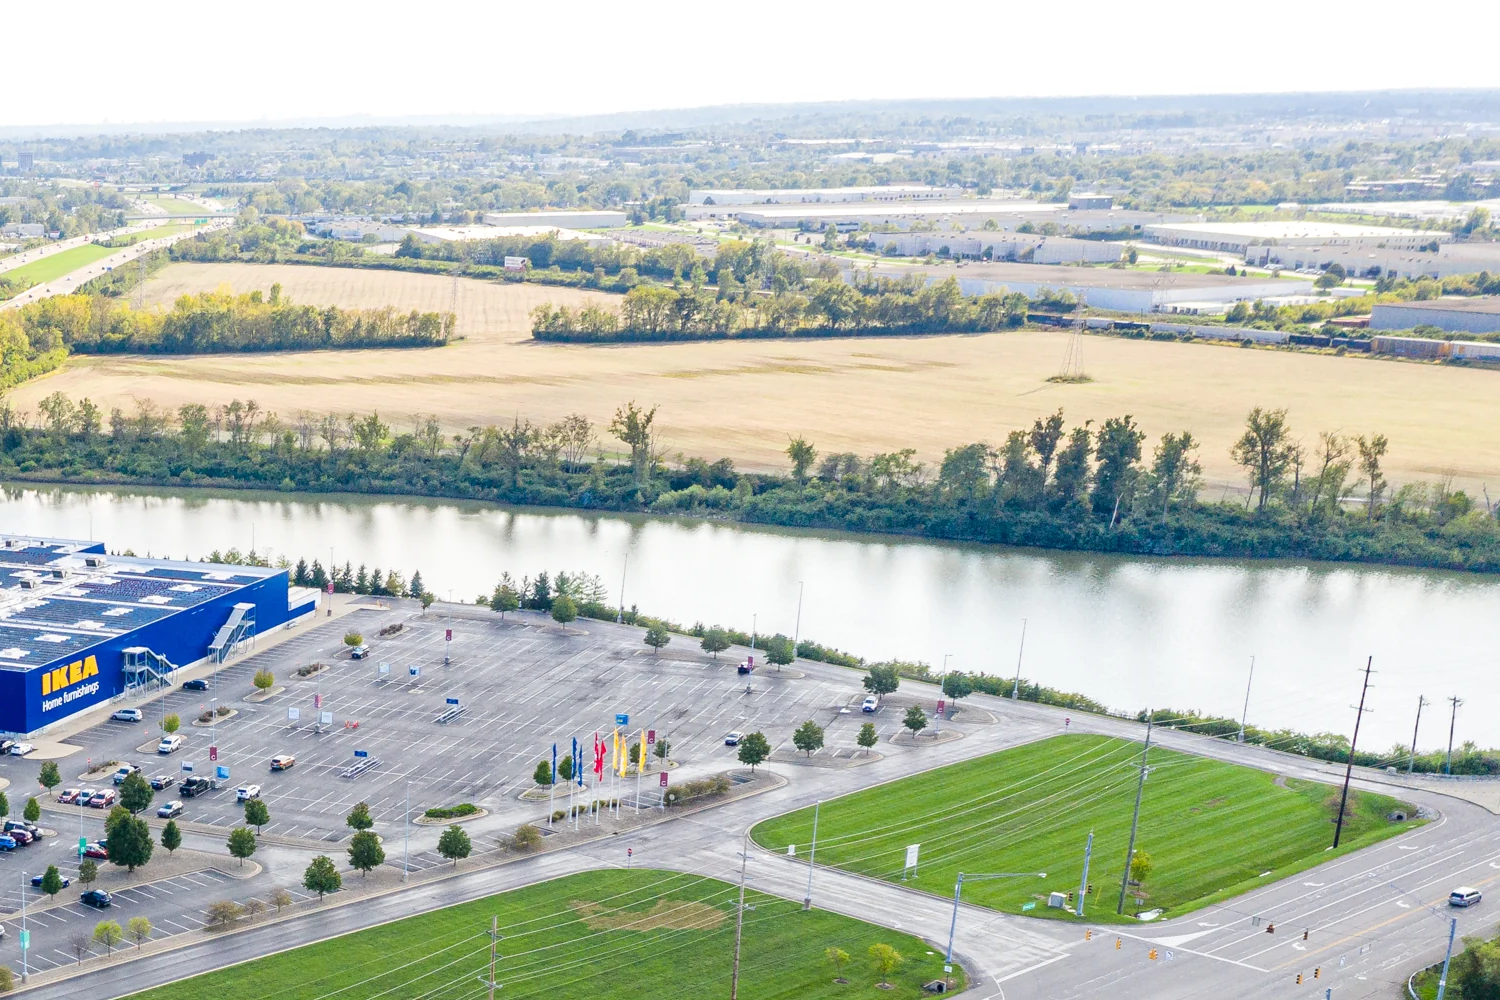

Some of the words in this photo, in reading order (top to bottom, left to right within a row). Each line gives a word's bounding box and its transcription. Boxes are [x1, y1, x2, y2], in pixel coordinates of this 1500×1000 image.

[42, 654, 99, 696] IKEA
[42, 698, 63, 712] Home
[63, 681, 99, 703] furnishings
